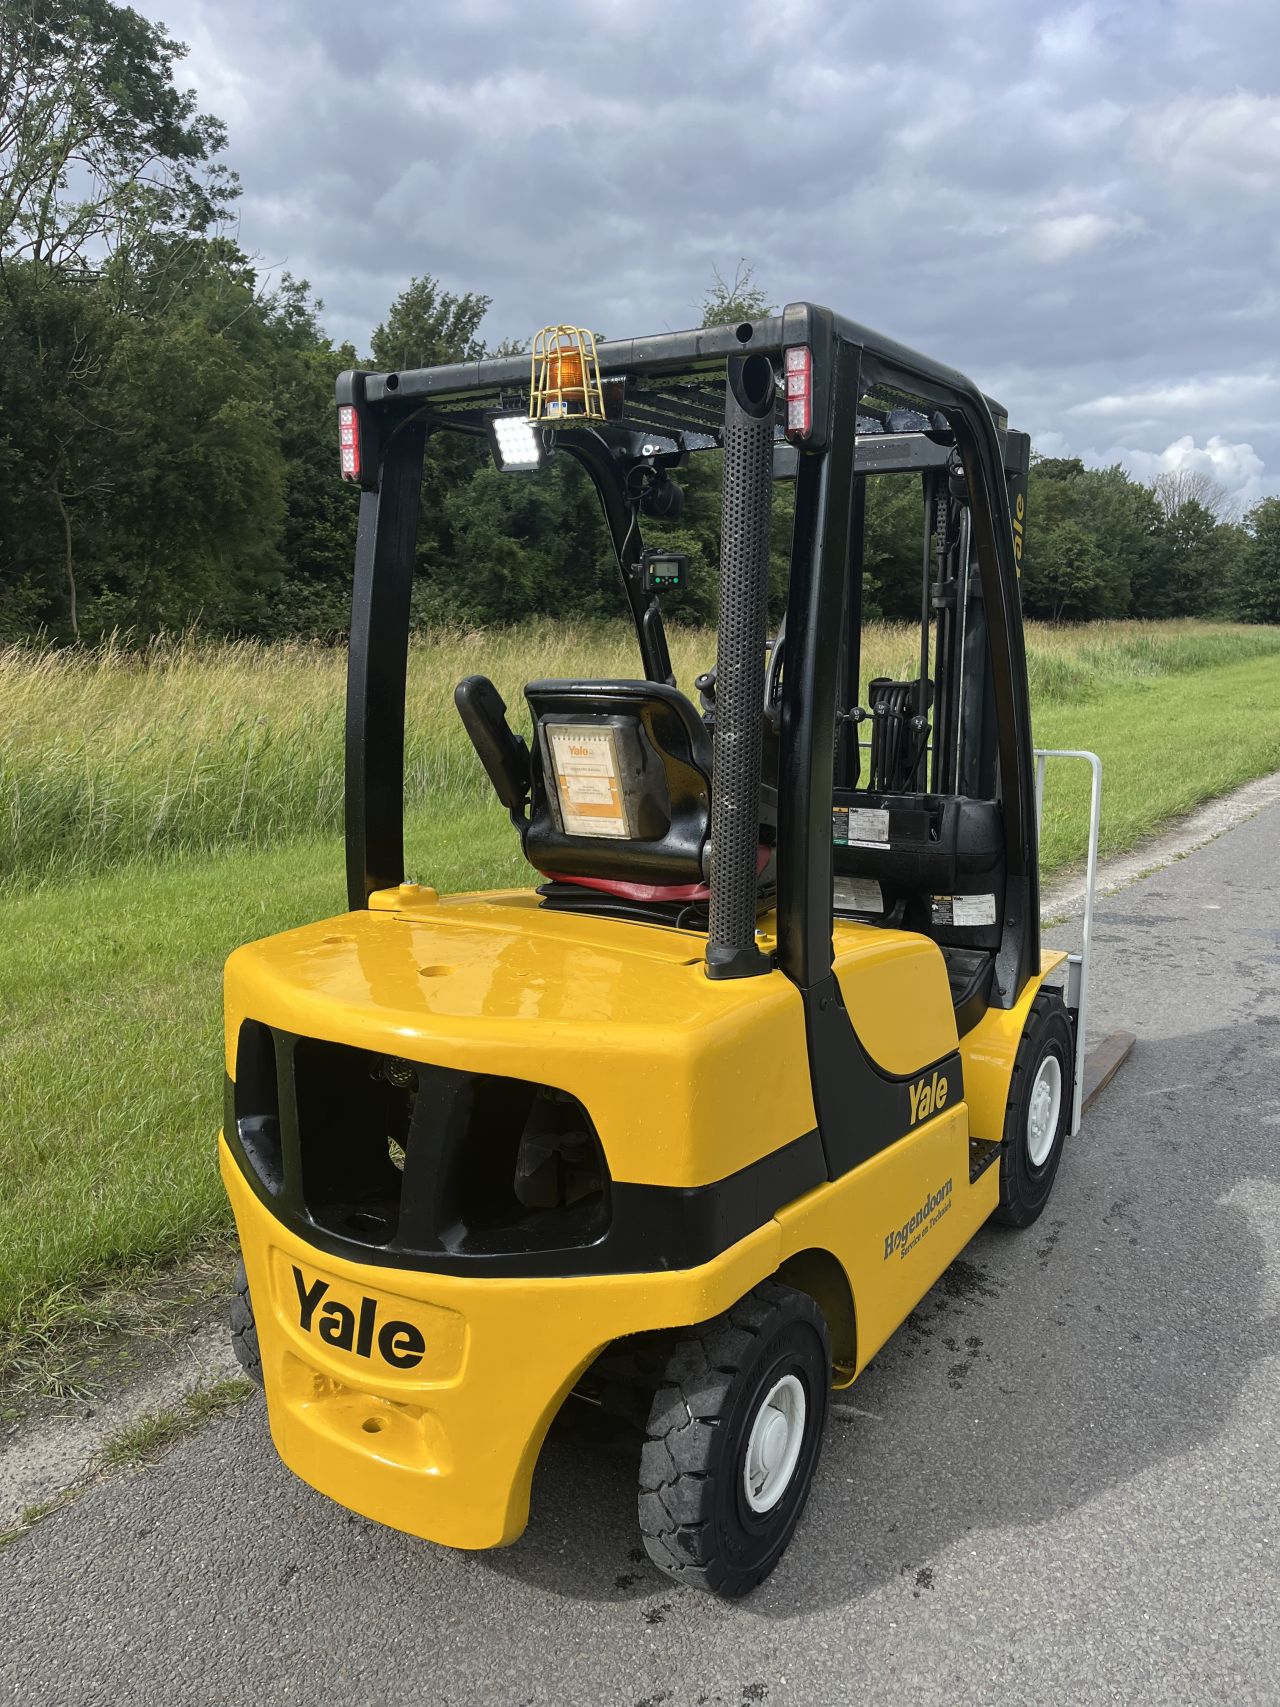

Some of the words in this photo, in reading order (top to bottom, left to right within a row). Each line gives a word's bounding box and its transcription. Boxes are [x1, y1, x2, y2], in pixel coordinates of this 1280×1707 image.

[909, 1071, 948, 1126] Yale
[883, 1177, 953, 1261] Hogendoorn
[900, 1234, 921, 1260] Service
[291, 1264, 426, 1369] Yale
